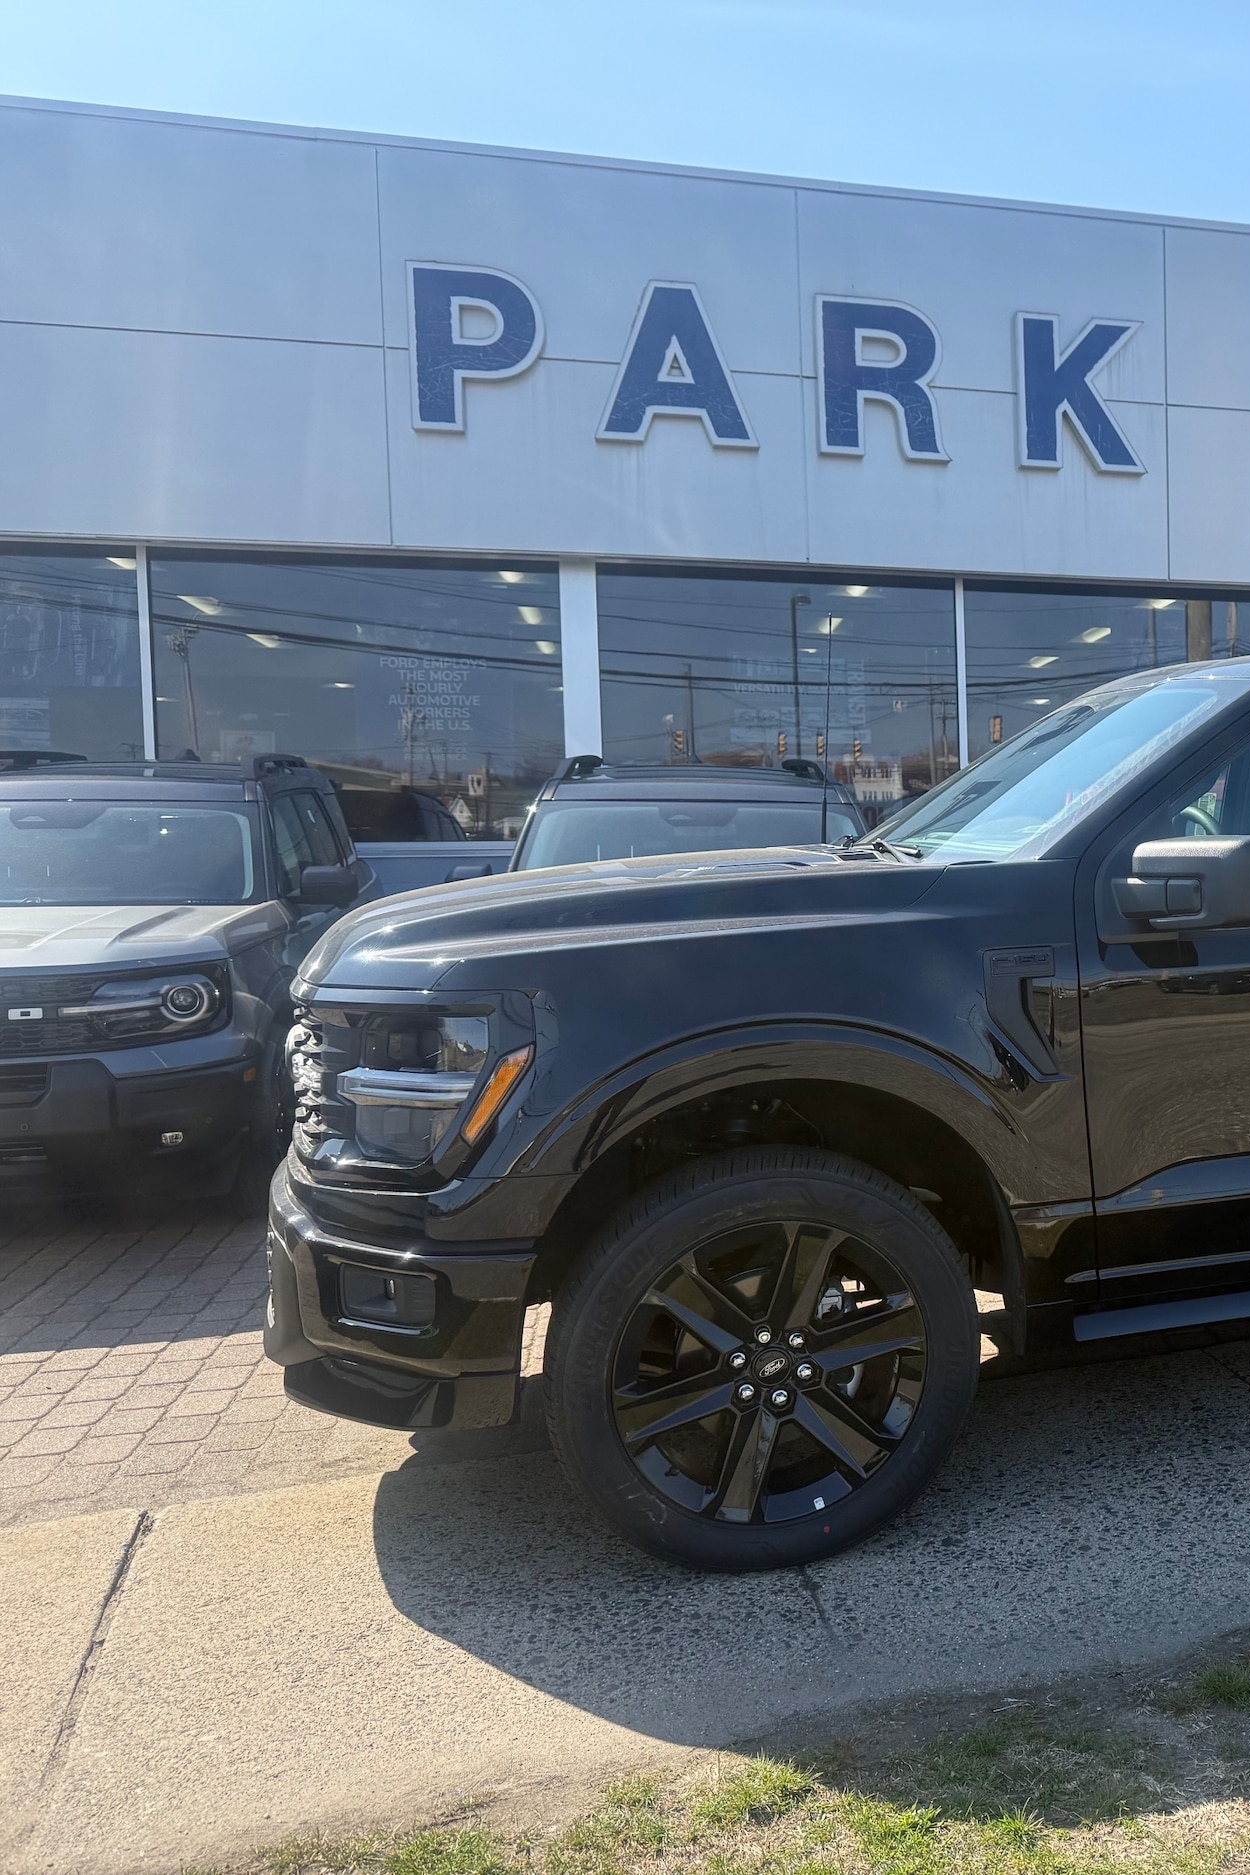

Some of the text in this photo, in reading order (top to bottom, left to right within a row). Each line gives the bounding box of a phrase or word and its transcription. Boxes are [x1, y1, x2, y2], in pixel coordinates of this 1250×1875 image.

[405, 260, 1147, 476] PARK
[380, 656, 487, 669] FORD EMPLOYS
[397, 669, 470, 681] THE MOST
[406, 682, 463, 693] HOURLY
[388, 695, 481, 706] AUTOMOTIVE
[400, 707, 471, 718] WORKERS
[416, 719, 444, 730] THE
[448, 719, 473, 731] U.S.
